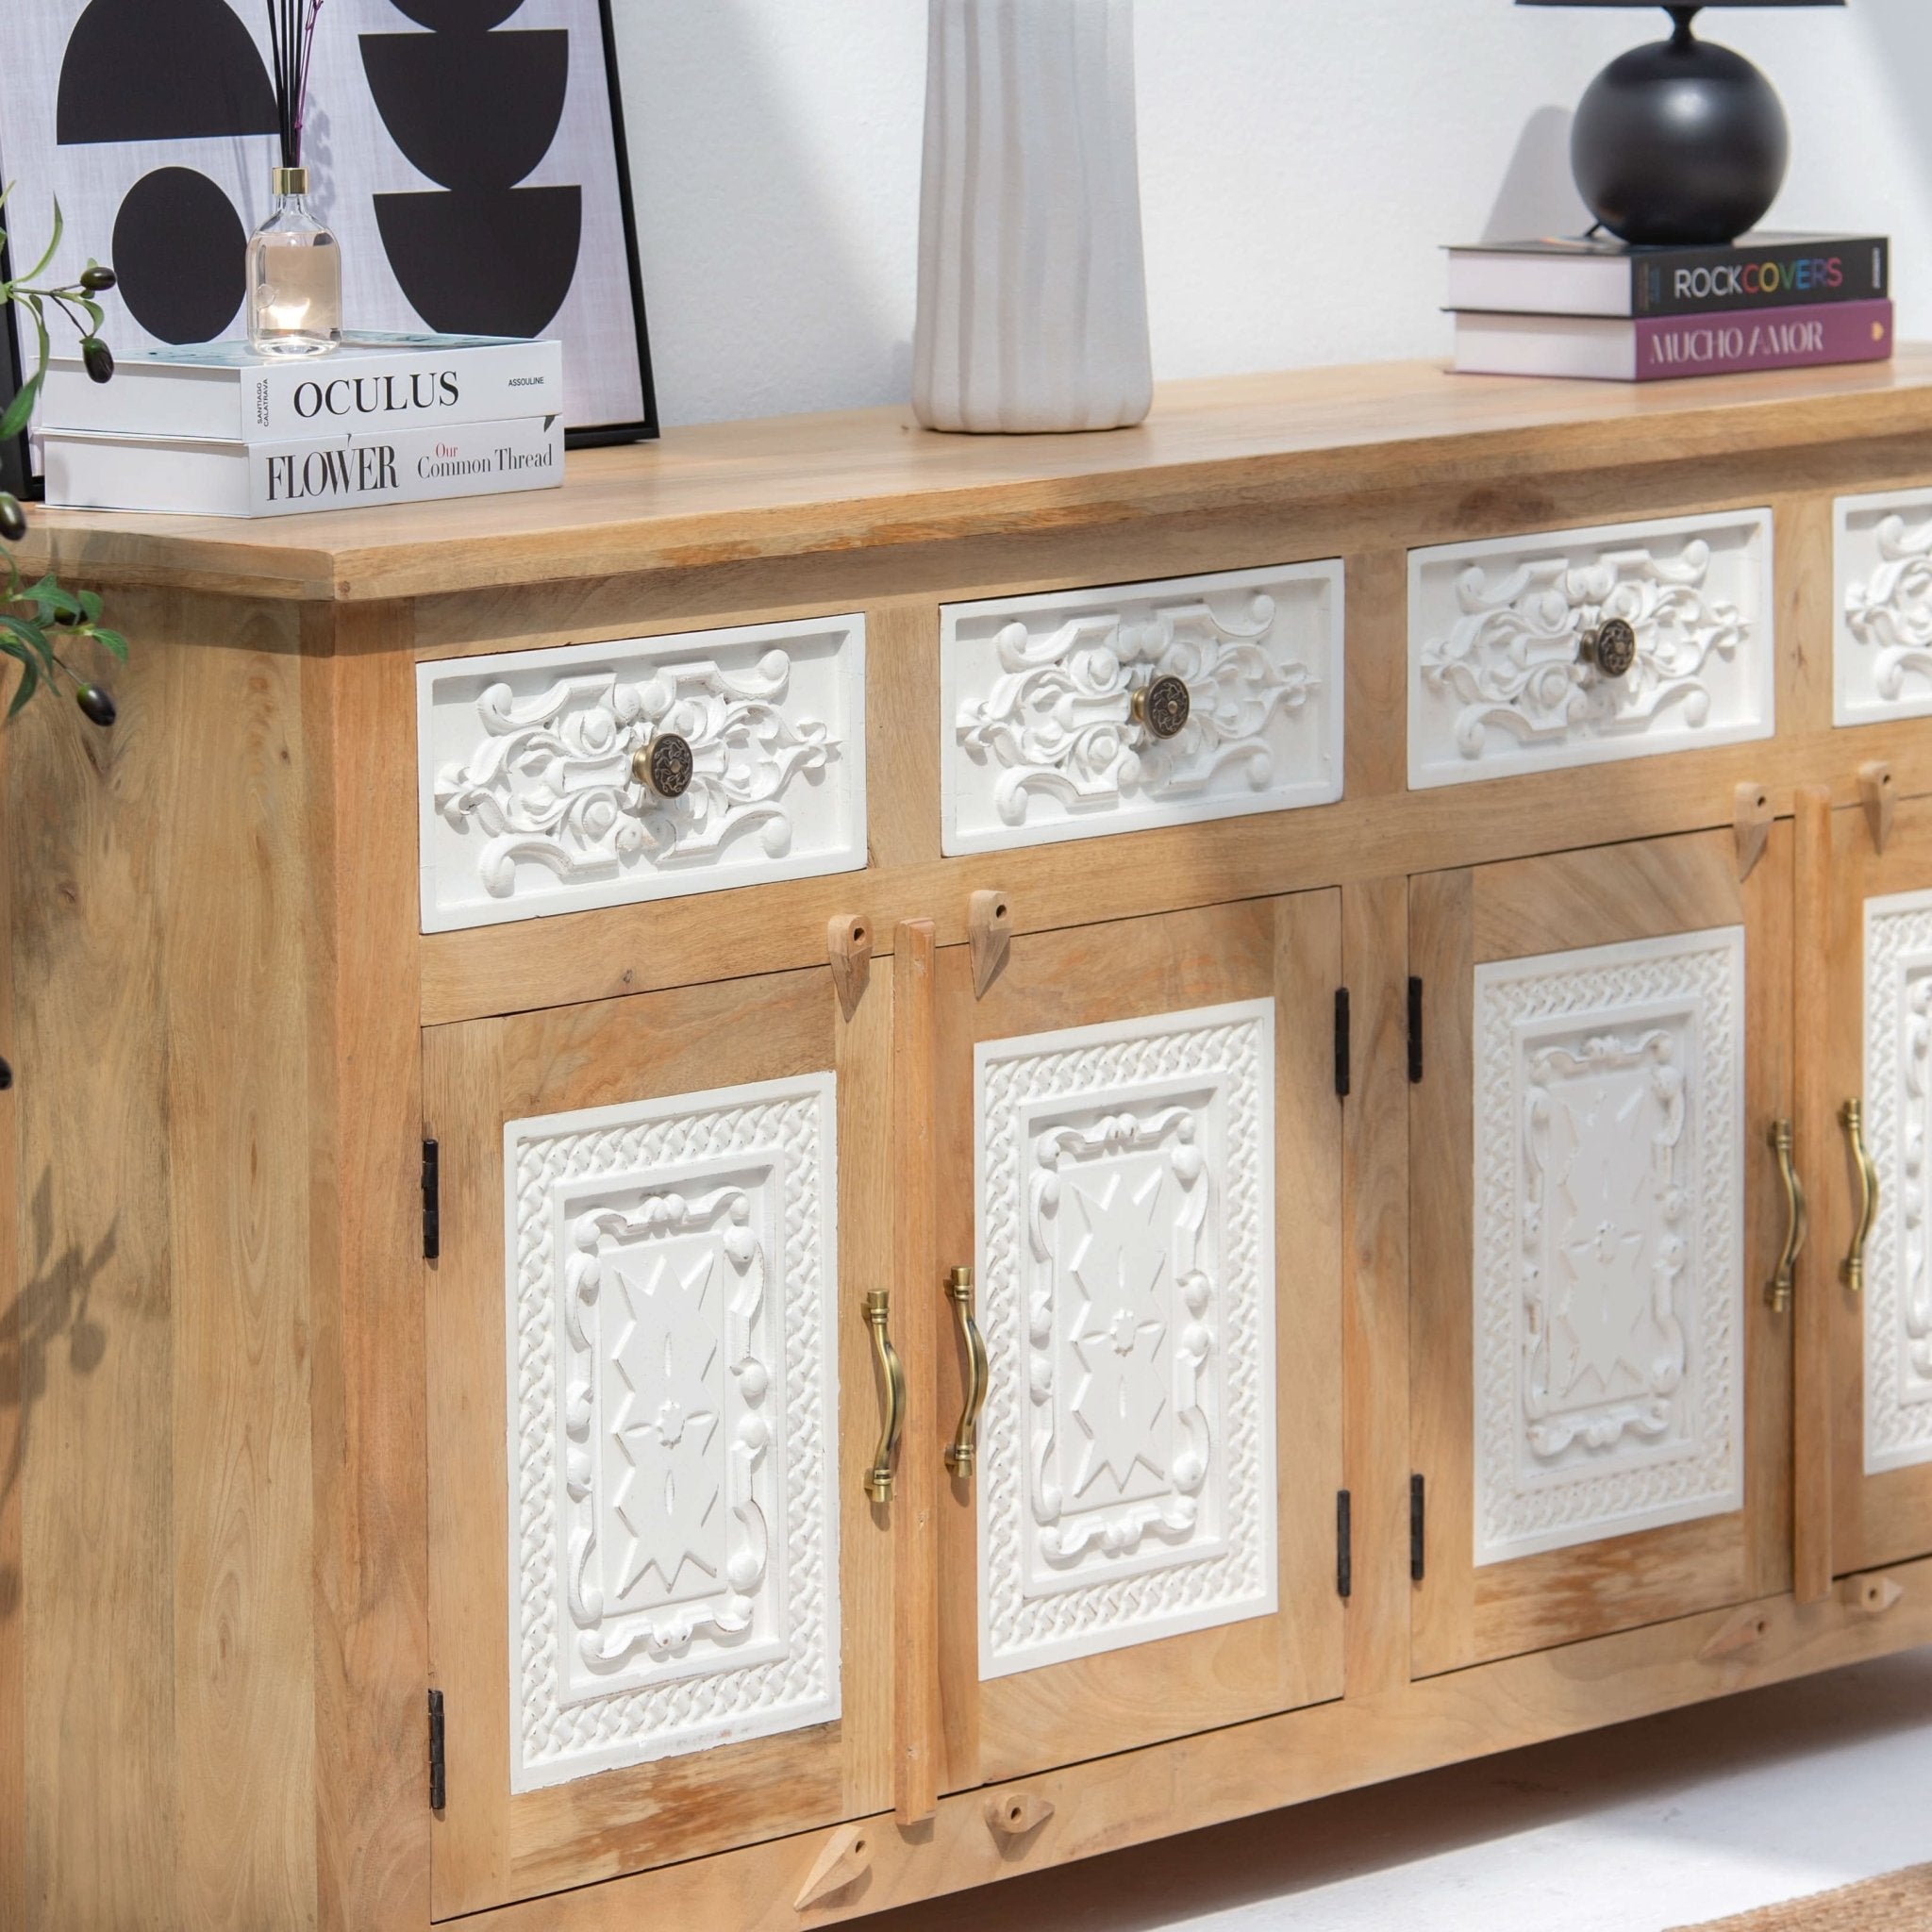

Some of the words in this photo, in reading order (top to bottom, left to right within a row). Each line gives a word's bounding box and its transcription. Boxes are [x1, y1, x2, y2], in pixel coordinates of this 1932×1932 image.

[1649, 326, 1744, 364] MUCHO
[1747, 321, 1824, 357] AMOR
[293, 371, 459, 417] OCULUS
[508, 376, 544, 387] ASSOULINE
[417, 457, 491, 479] Common
[494, 443, 553, 471] Thread
[435, 441, 458, 458] Our
[265, 444, 400, 501] FLOWER
